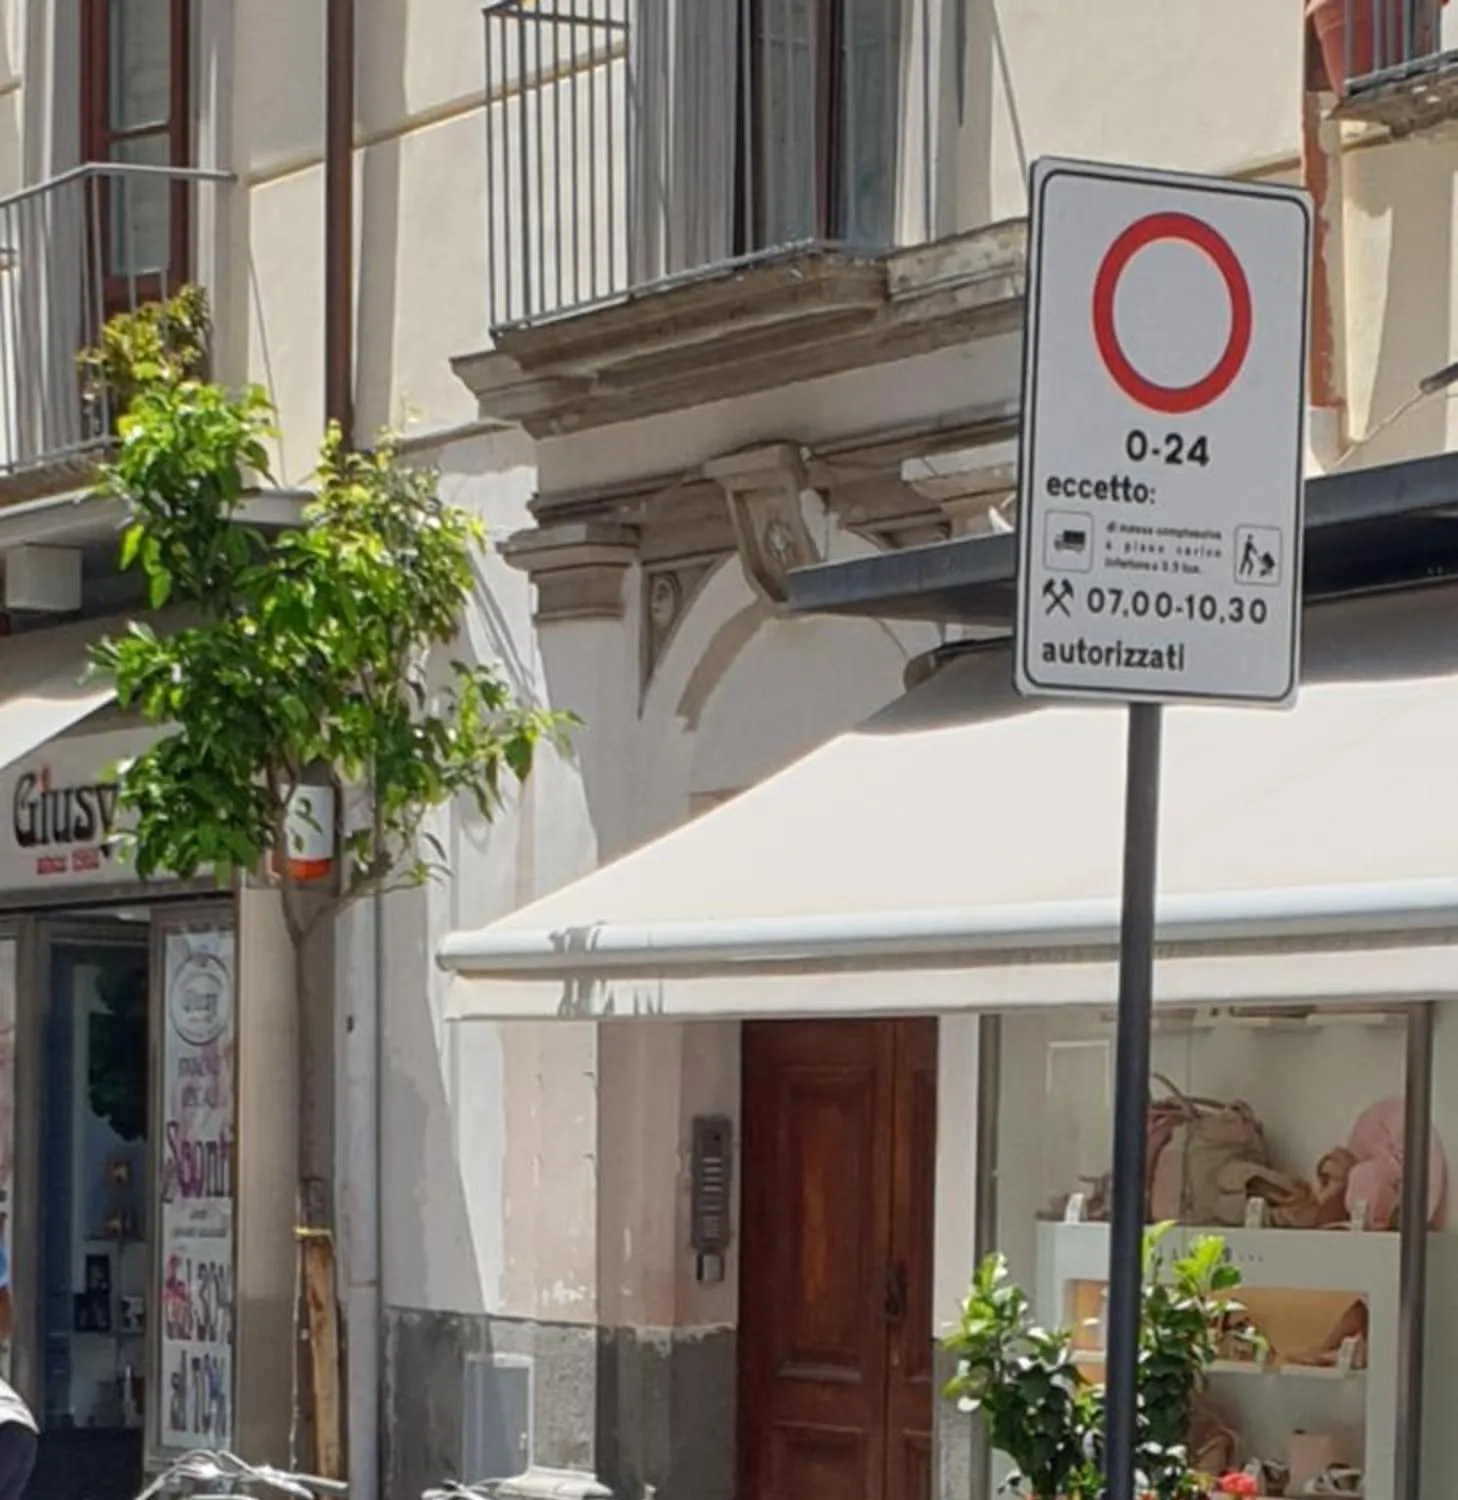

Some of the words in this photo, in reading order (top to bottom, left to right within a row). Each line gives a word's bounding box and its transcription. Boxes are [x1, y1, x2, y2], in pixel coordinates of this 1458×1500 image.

[1125, 429, 1210, 467] 0-24
[1046, 474, 1156, 504] eccetto:
[1042, 638, 1185, 671] autorizzati
[13, 767, 118, 858] Giusy
